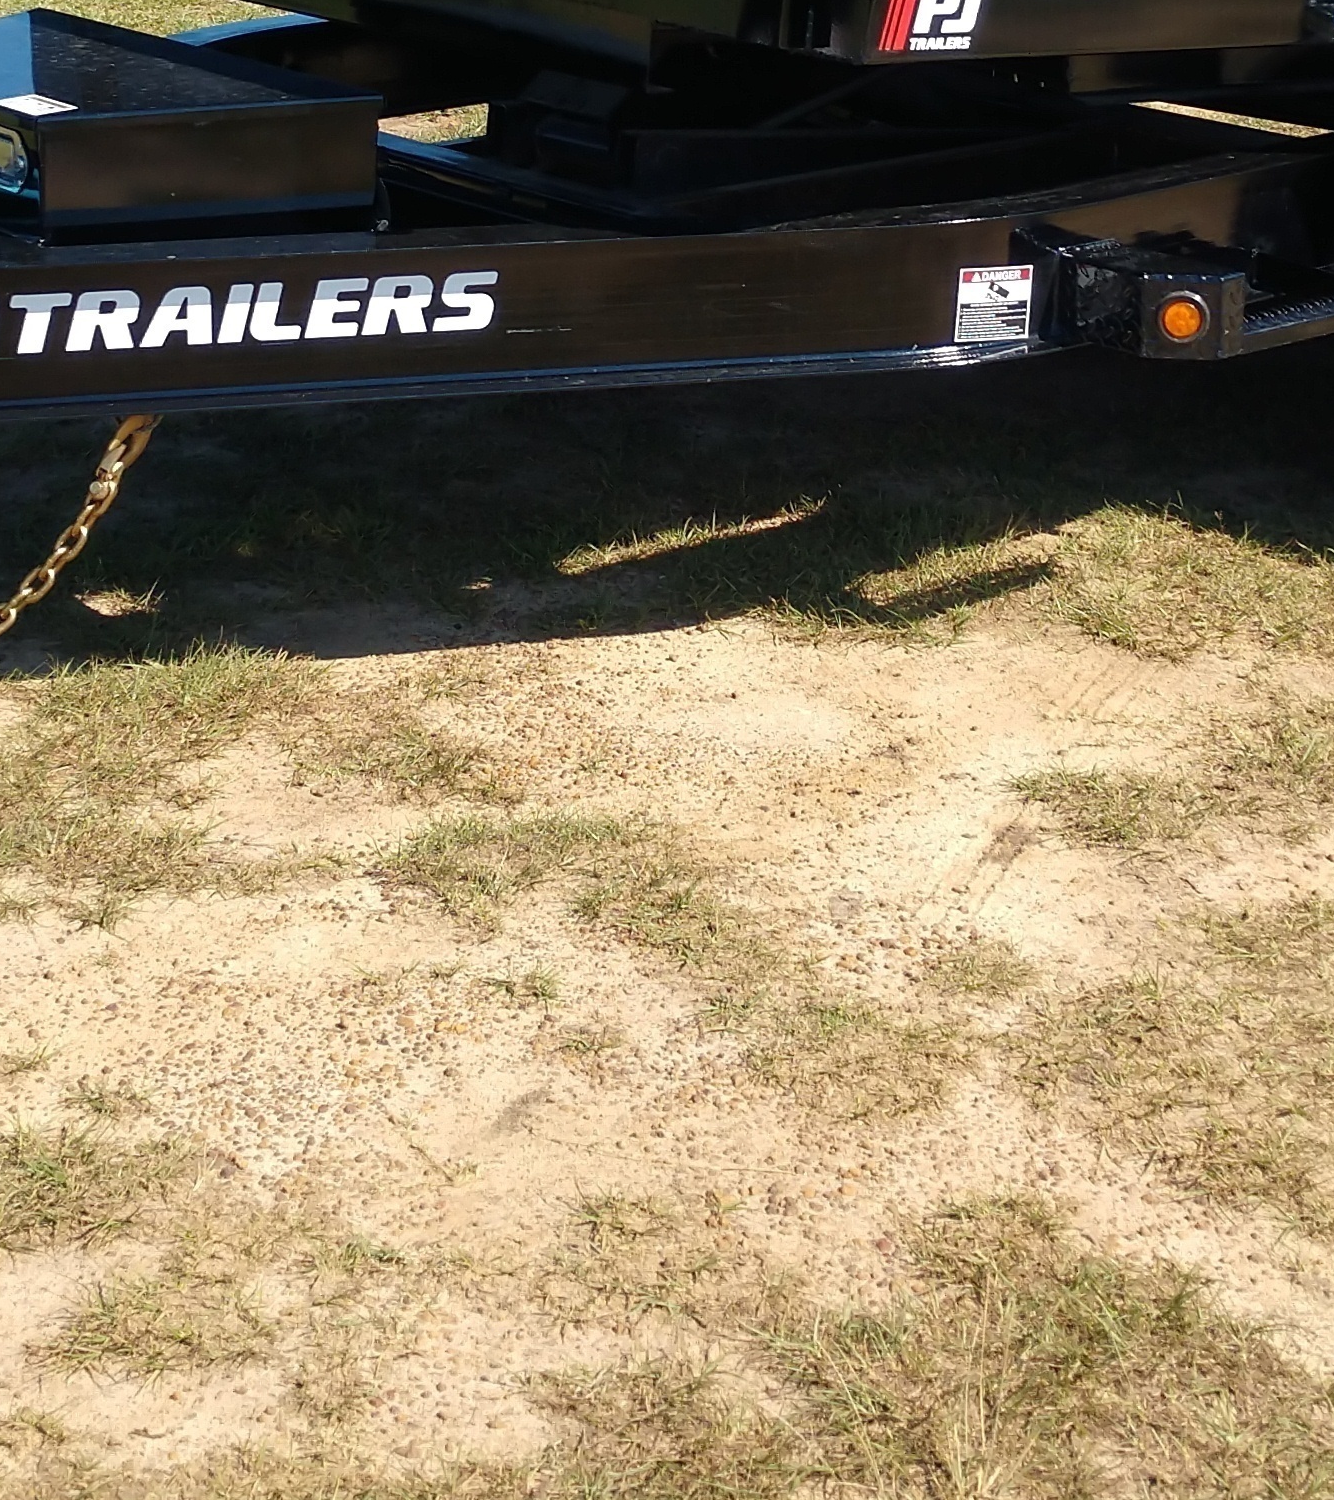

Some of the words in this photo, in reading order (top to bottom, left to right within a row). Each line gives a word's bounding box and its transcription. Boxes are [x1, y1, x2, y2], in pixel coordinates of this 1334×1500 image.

[909, 36, 971, 51] TRAILERS
[981, 269, 1022, 282] DANGER
[8, 270, 499, 355] TRAILERS
